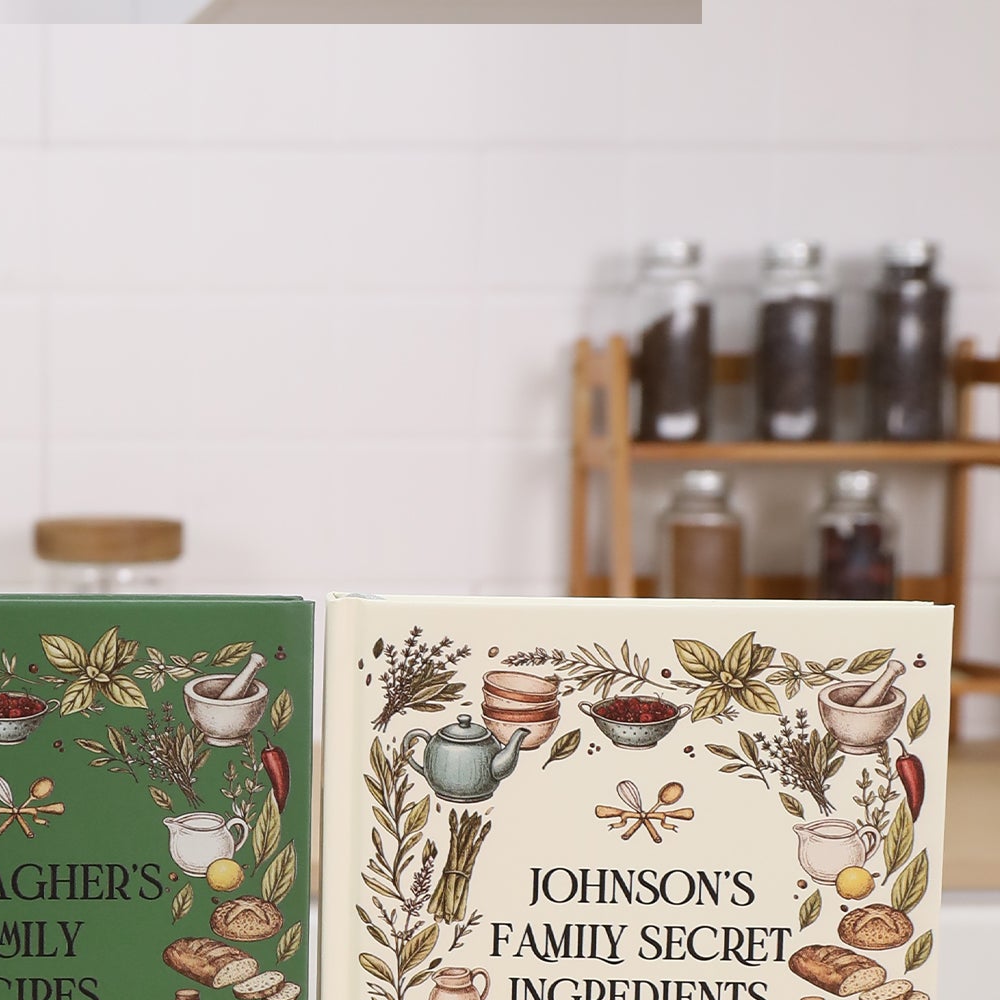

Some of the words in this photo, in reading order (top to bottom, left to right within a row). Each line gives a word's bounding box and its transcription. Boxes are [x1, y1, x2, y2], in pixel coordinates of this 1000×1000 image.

[528, 867, 756, 907] JOHNSON'S
[489, 922, 629, 965] FAMILY
[638, 925, 792, 967] SECRET
